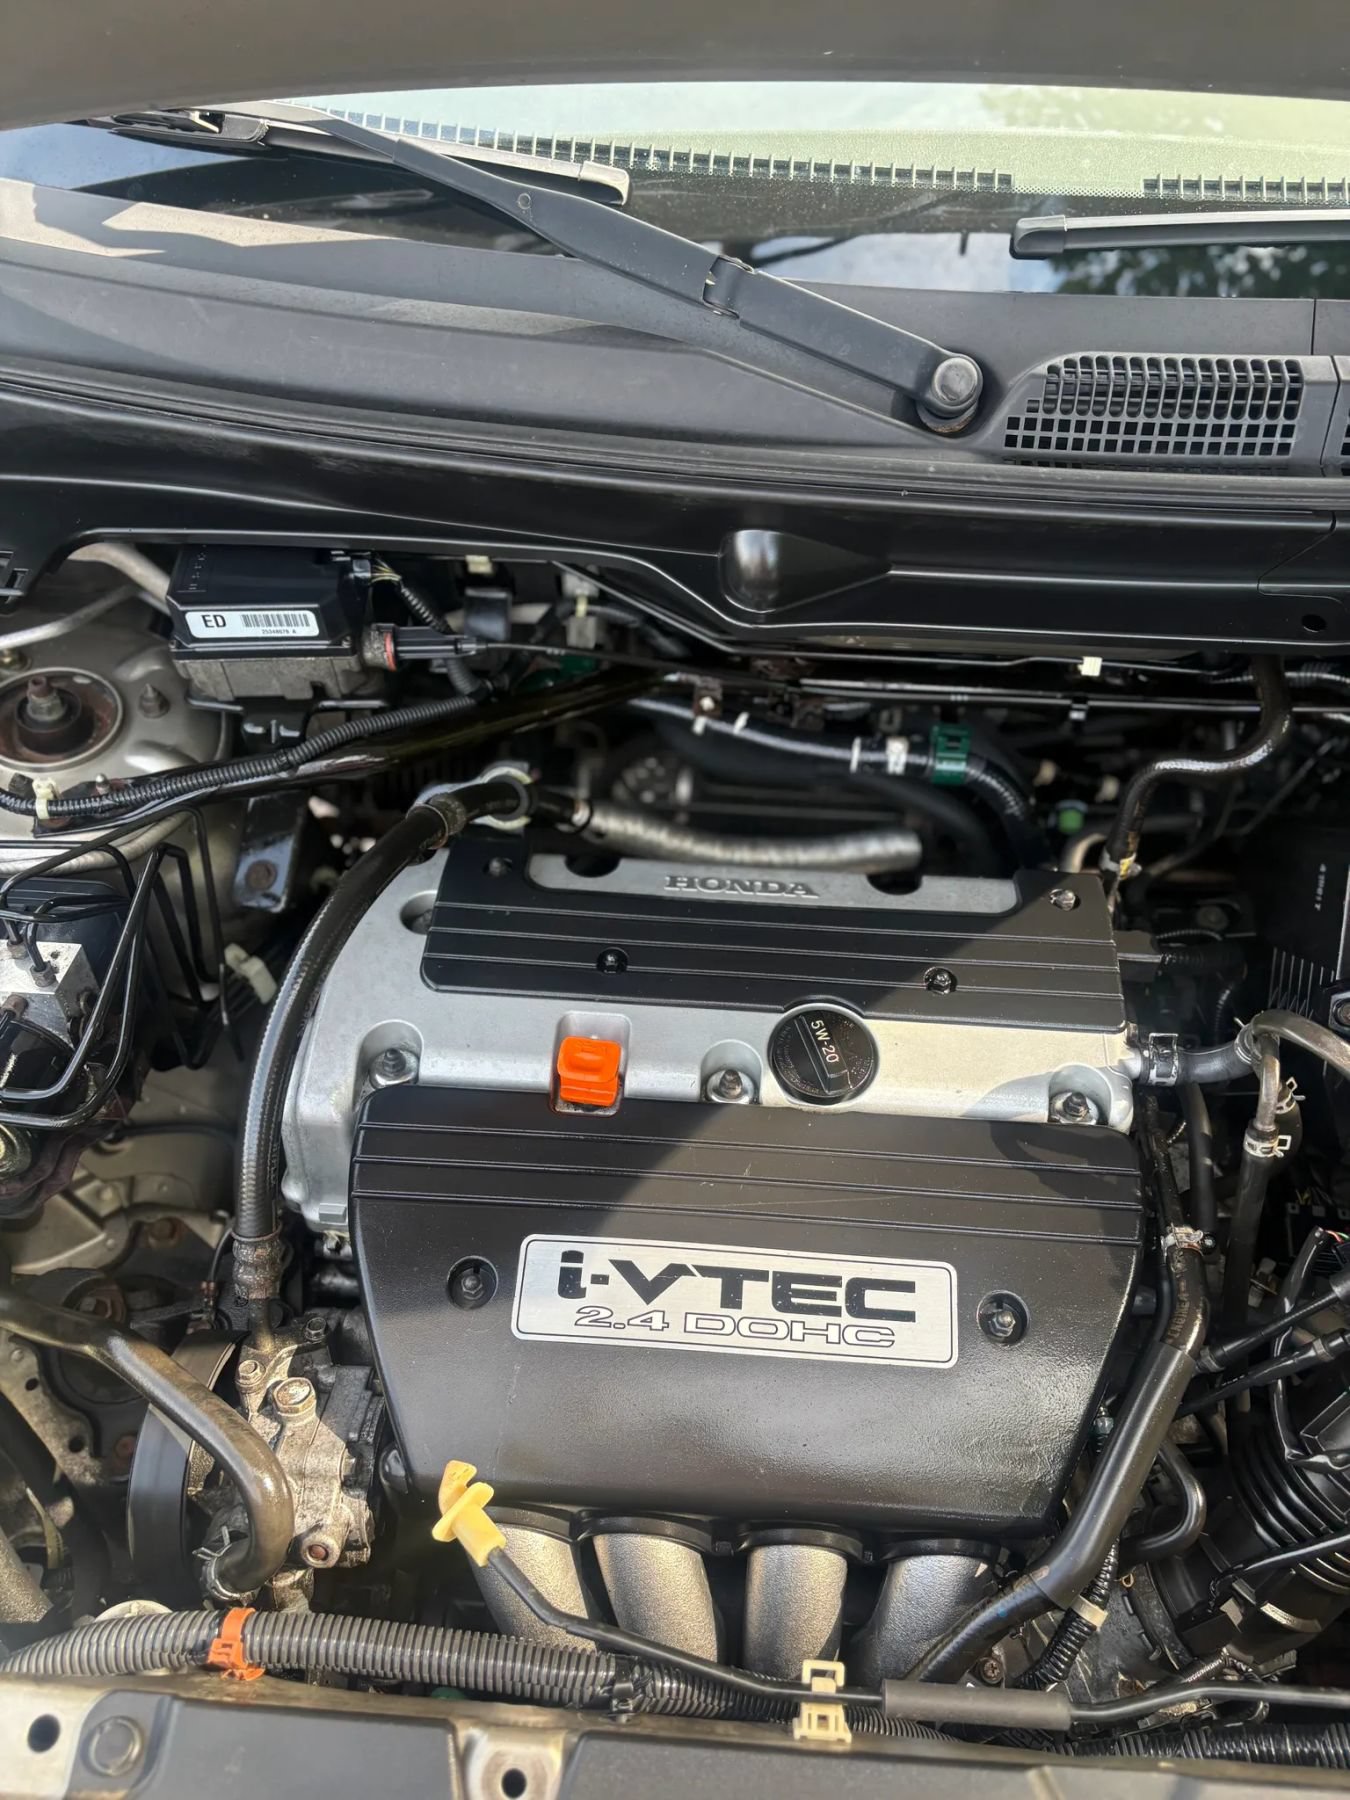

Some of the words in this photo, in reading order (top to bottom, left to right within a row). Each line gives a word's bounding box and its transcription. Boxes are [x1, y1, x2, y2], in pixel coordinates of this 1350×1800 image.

[201, 614, 227, 628] ED
[664, 875, 820, 899] HONDA
[811, 1020, 840, 1063] 5W-20
[557, 1249, 917, 1323] i-VTEC
[574, 1305, 670, 1332] 2.4
[683, 1312, 896, 1349] DOHC
